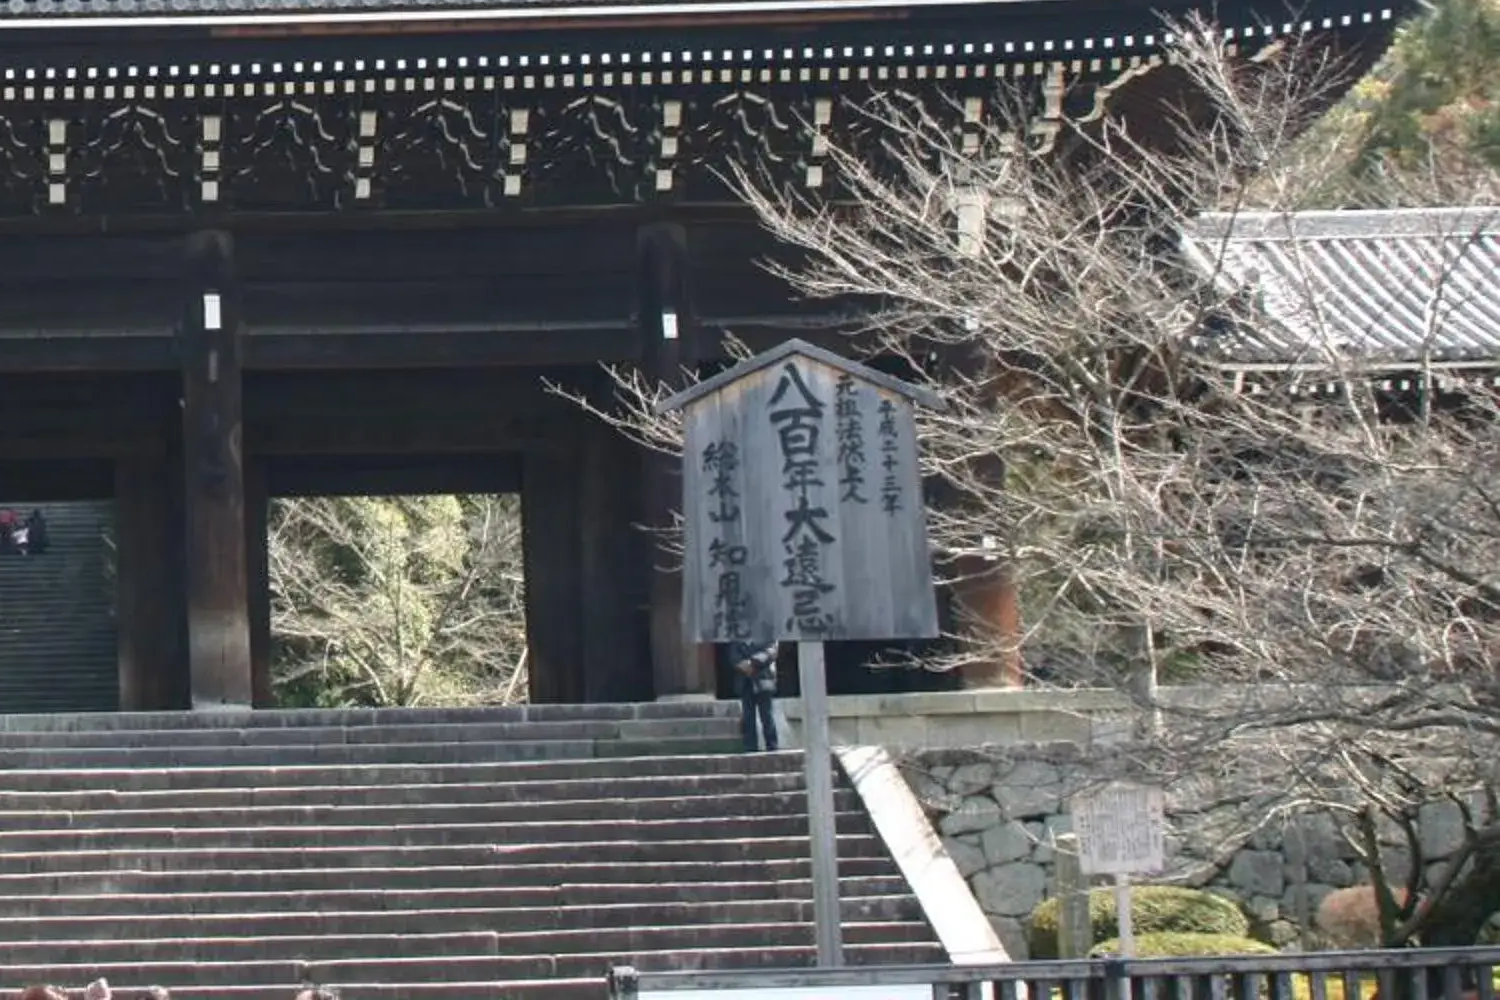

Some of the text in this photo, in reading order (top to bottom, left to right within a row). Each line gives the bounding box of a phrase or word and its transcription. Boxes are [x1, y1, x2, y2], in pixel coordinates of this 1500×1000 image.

[768, 362, 836, 633] 八百年大遠忌
[835, 373, 867, 505] 元祖法然上人
[877, 399, 904, 518] 平成二十三年
